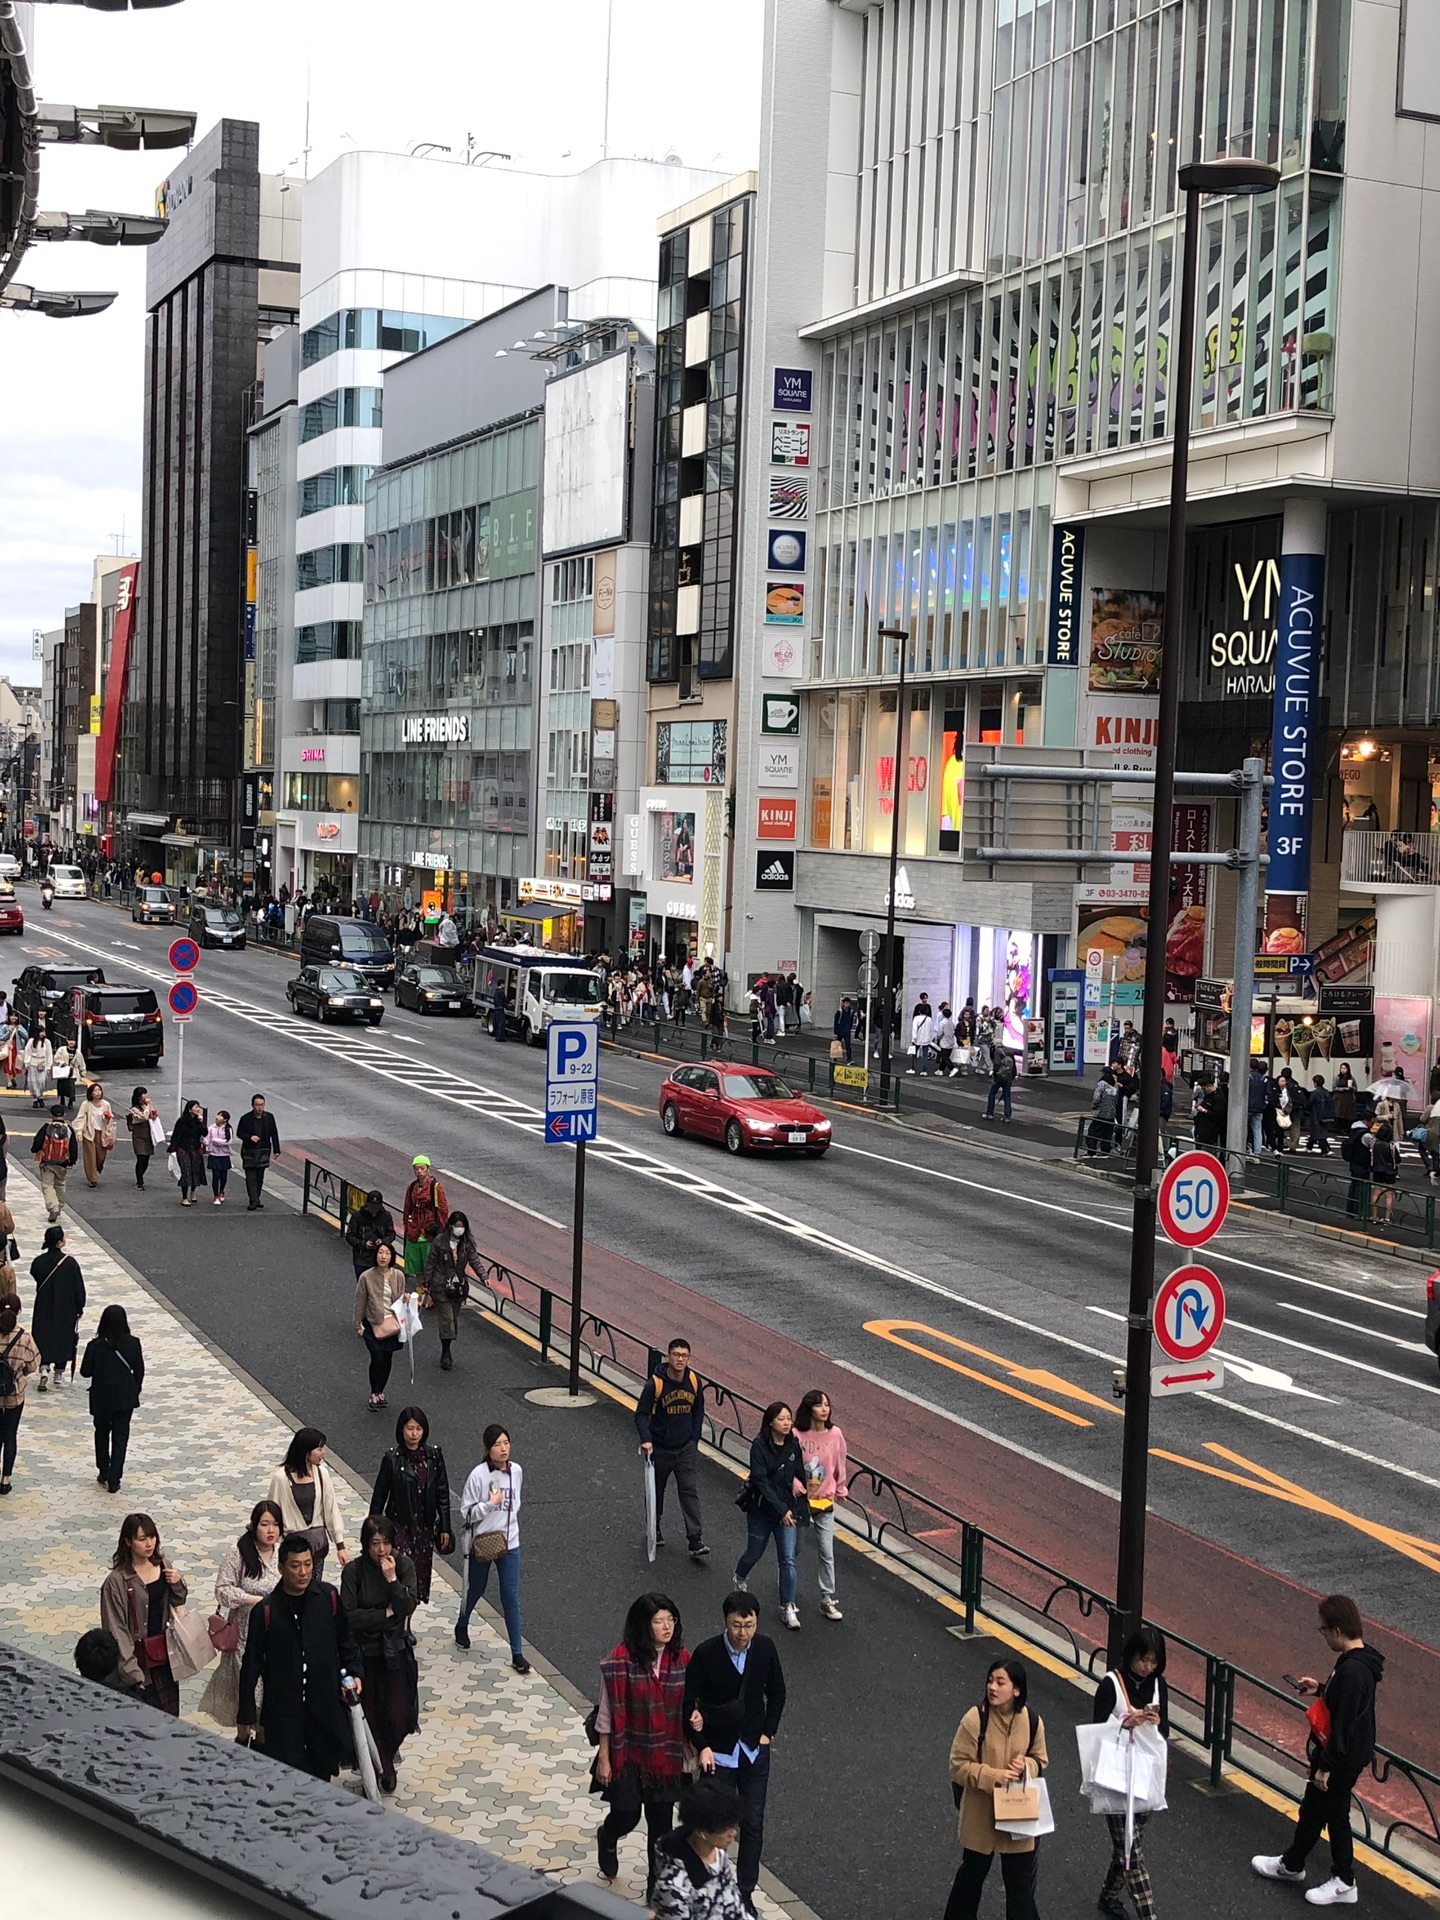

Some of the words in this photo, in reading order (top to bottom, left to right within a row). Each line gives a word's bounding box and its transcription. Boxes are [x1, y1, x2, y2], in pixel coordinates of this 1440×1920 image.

[784, 377, 802, 389] YM
[778, 389, 807, 398] SQUARE
[1060, 530, 1076, 604] ACUVUE
[1057, 608, 1073, 661] STORE
[1119, 628, 1141, 640] café
[1210, 628, 1278, 668] SQUA
[1285, 585, 1315, 713] ACUVUE
[1227, 675, 1276, 694] HARAJ
[401, 718, 423, 742] LINE
[424, 716, 467, 742] FRIENDS
[1095, 716, 1159, 746] KINJI
[770, 754, 788, 765] YM
[1122, 747, 1153, 757] clothing
[764, 765, 793, 774] SQUARE
[1279, 725, 1308, 816] STORE
[761, 810, 793, 822] KINJI
[630, 816, 639, 873] GUESS
[1277, 837, 1303, 855] 3F
[412, 851, 425, 866] LINE
[425, 852, 449, 869] FRIENDS
[1182, 809, 1197, 910] ローストーフ大野
[761, 873, 789, 881] adidas
[884, 887, 915, 909] aidas
[1085, 889, 1095, 897] 3F
[1106, 889, 1150, 898] 03-3470-82
[666, 901, 697, 918] GUESS
[1289, 957, 1300, 972] P
[1322, 990, 1370, 998] とろけるクレープ
[557, 1031, 587, 1075] P
[570, 1063, 592, 1075] 9-22
[550, 1088, 594, 1106] ラフォーレ原宿
[570, 1114, 593, 1136] IN
[1175, 1178, 1213, 1221] 50
